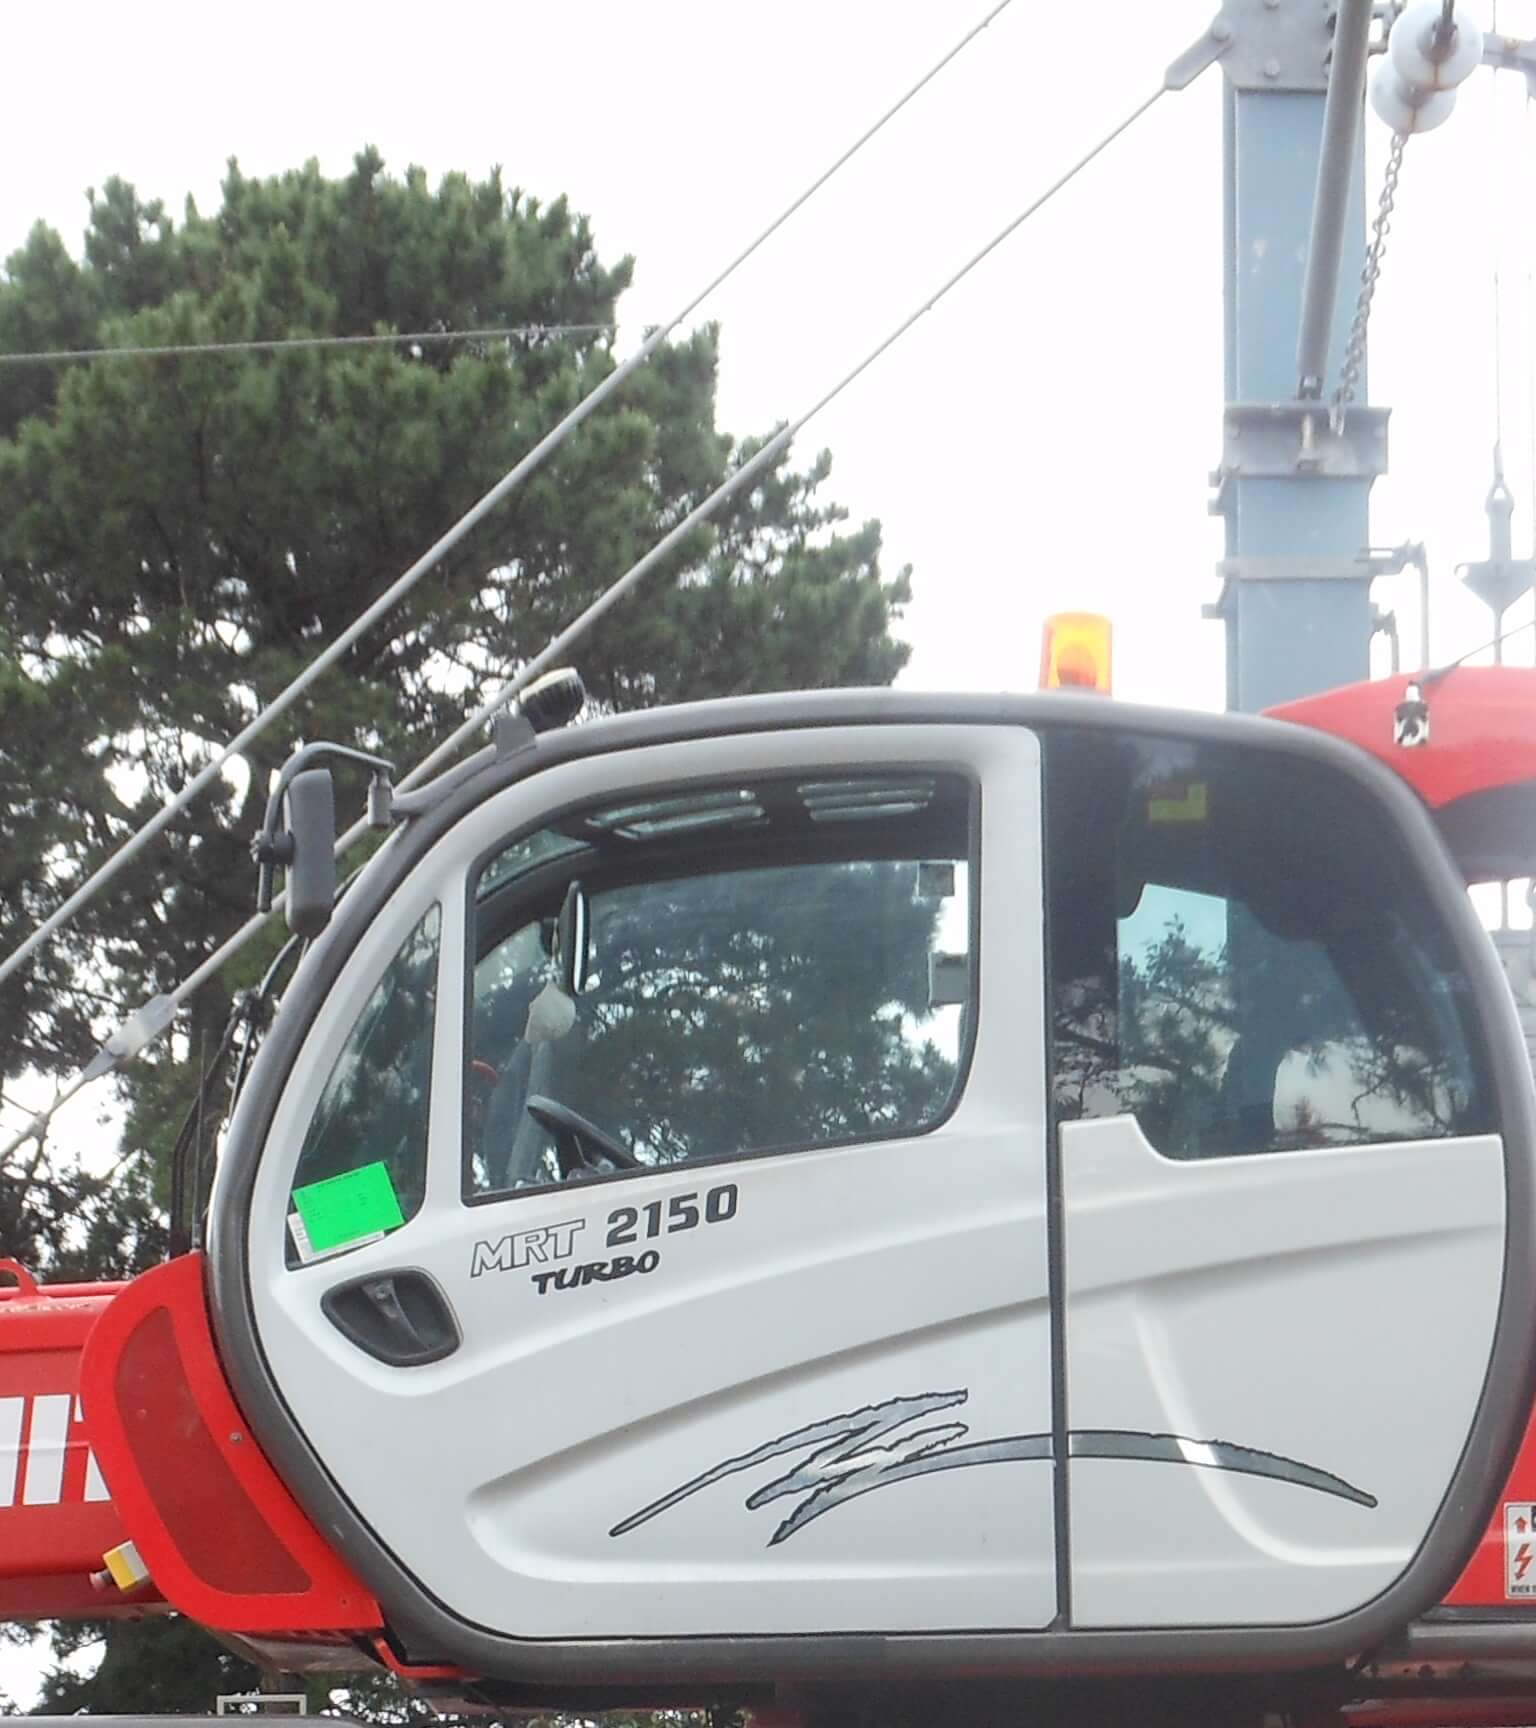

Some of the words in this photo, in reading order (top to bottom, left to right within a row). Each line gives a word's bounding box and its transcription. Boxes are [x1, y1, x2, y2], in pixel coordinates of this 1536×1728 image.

[470, 1218, 586, 1279] MRT
[605, 1183, 739, 1249] 2150
[530, 1249, 661, 1295] TURBO
